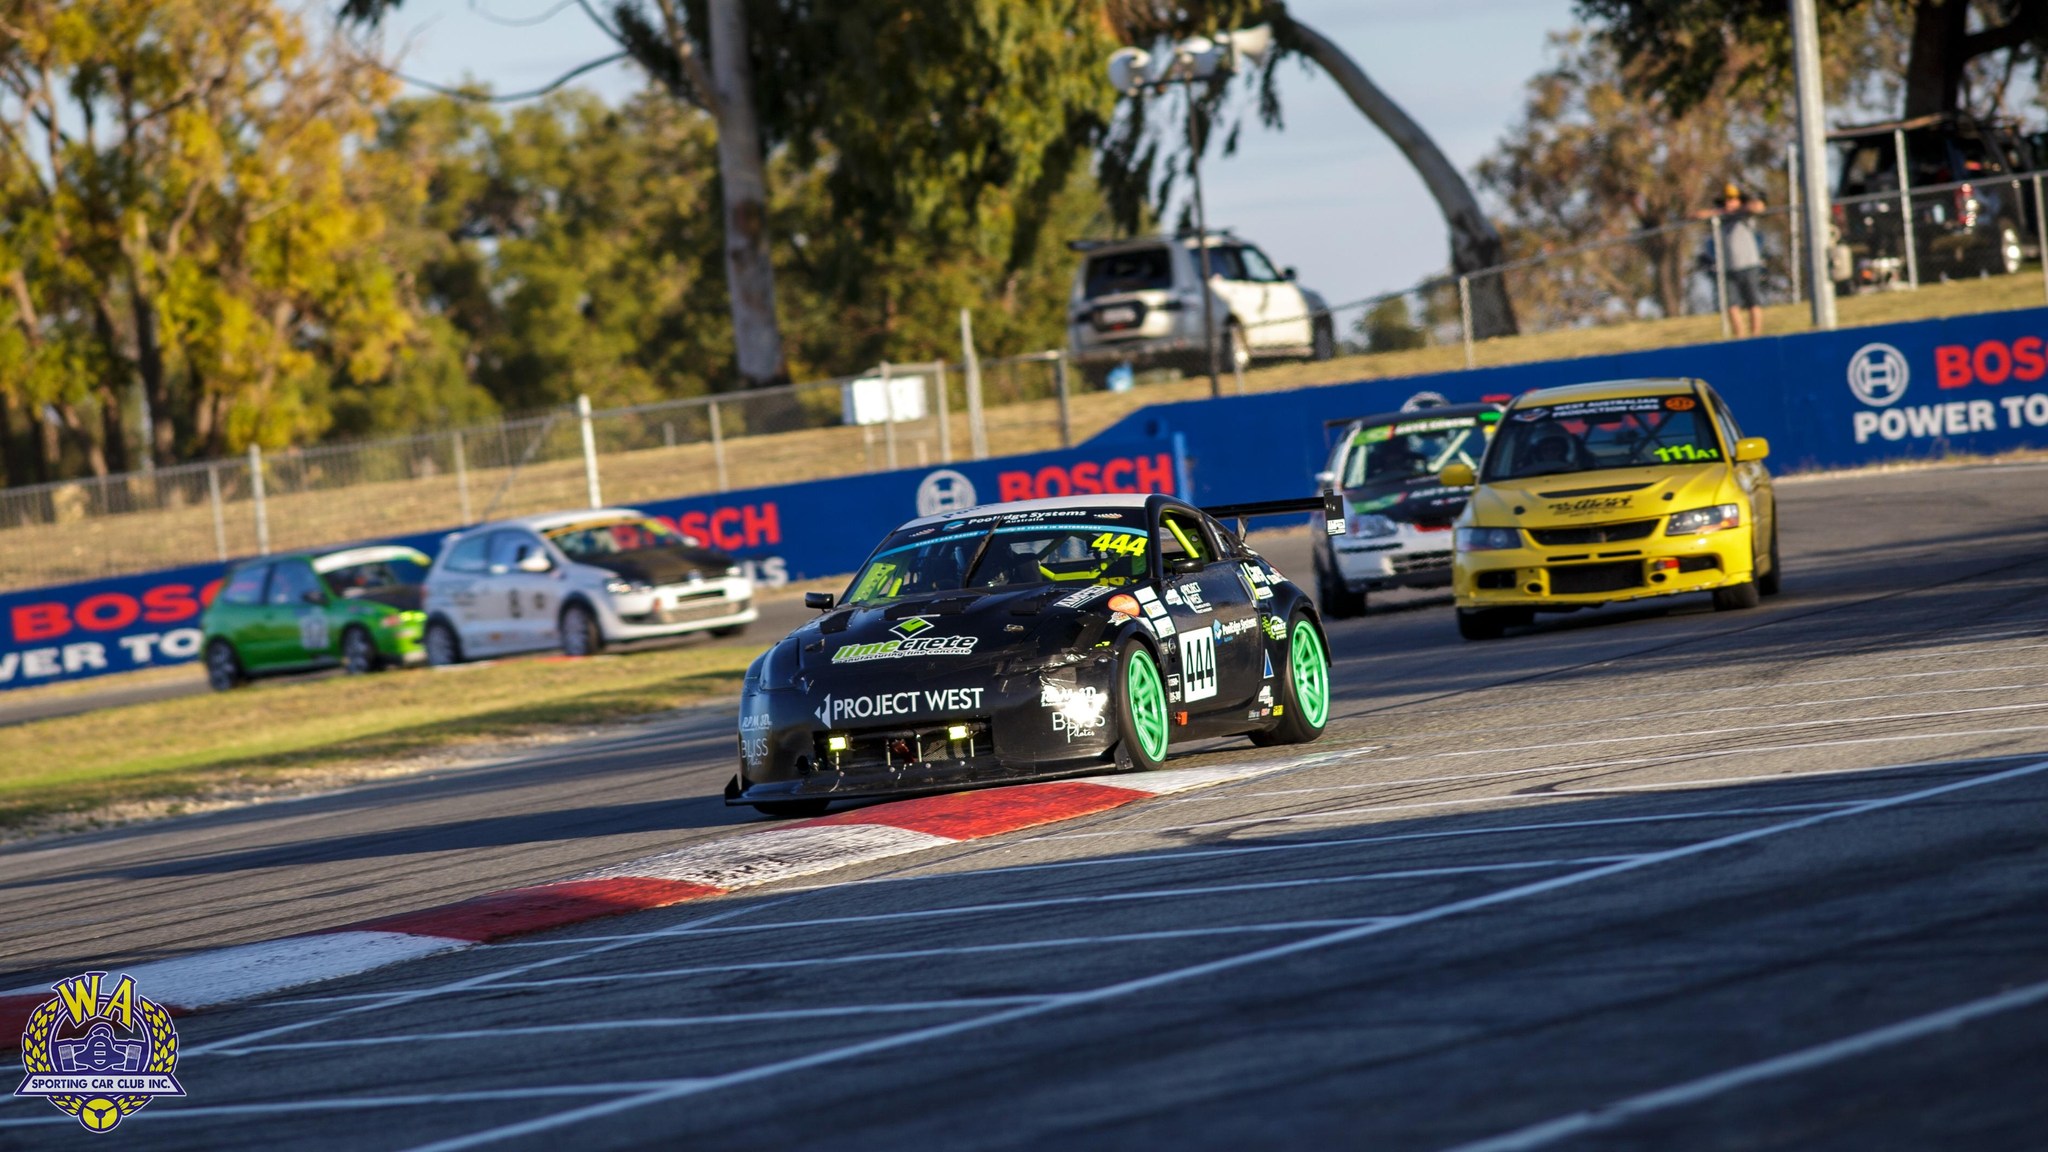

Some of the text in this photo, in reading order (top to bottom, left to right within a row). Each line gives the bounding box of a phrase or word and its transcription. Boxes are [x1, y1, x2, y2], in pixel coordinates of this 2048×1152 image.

[1934, 336, 2048, 389] BOS
[1551, 403, 1661, 418] PRODUCTION CARS
[1553, 397, 1660, 412] WEST AUSTRALIAN
[1853, 398, 1997, 443] POWER
[1653, 443, 1697, 463] 111
[998, 452, 1175, 503] BOSCH
[1004, 516, 1045, 524] Australia
[1029, 510, 1087, 521] Systems
[1091, 532, 1148, 557] 444
[118, 627, 205, 664] TO
[832, 635, 979, 661] limecrete
[926, 648, 972, 656] concrete
[1186, 636, 1215, 692] 444
[833, 687, 984, 721] PROJECT WEST
[741, 738, 769, 759] BLISS
